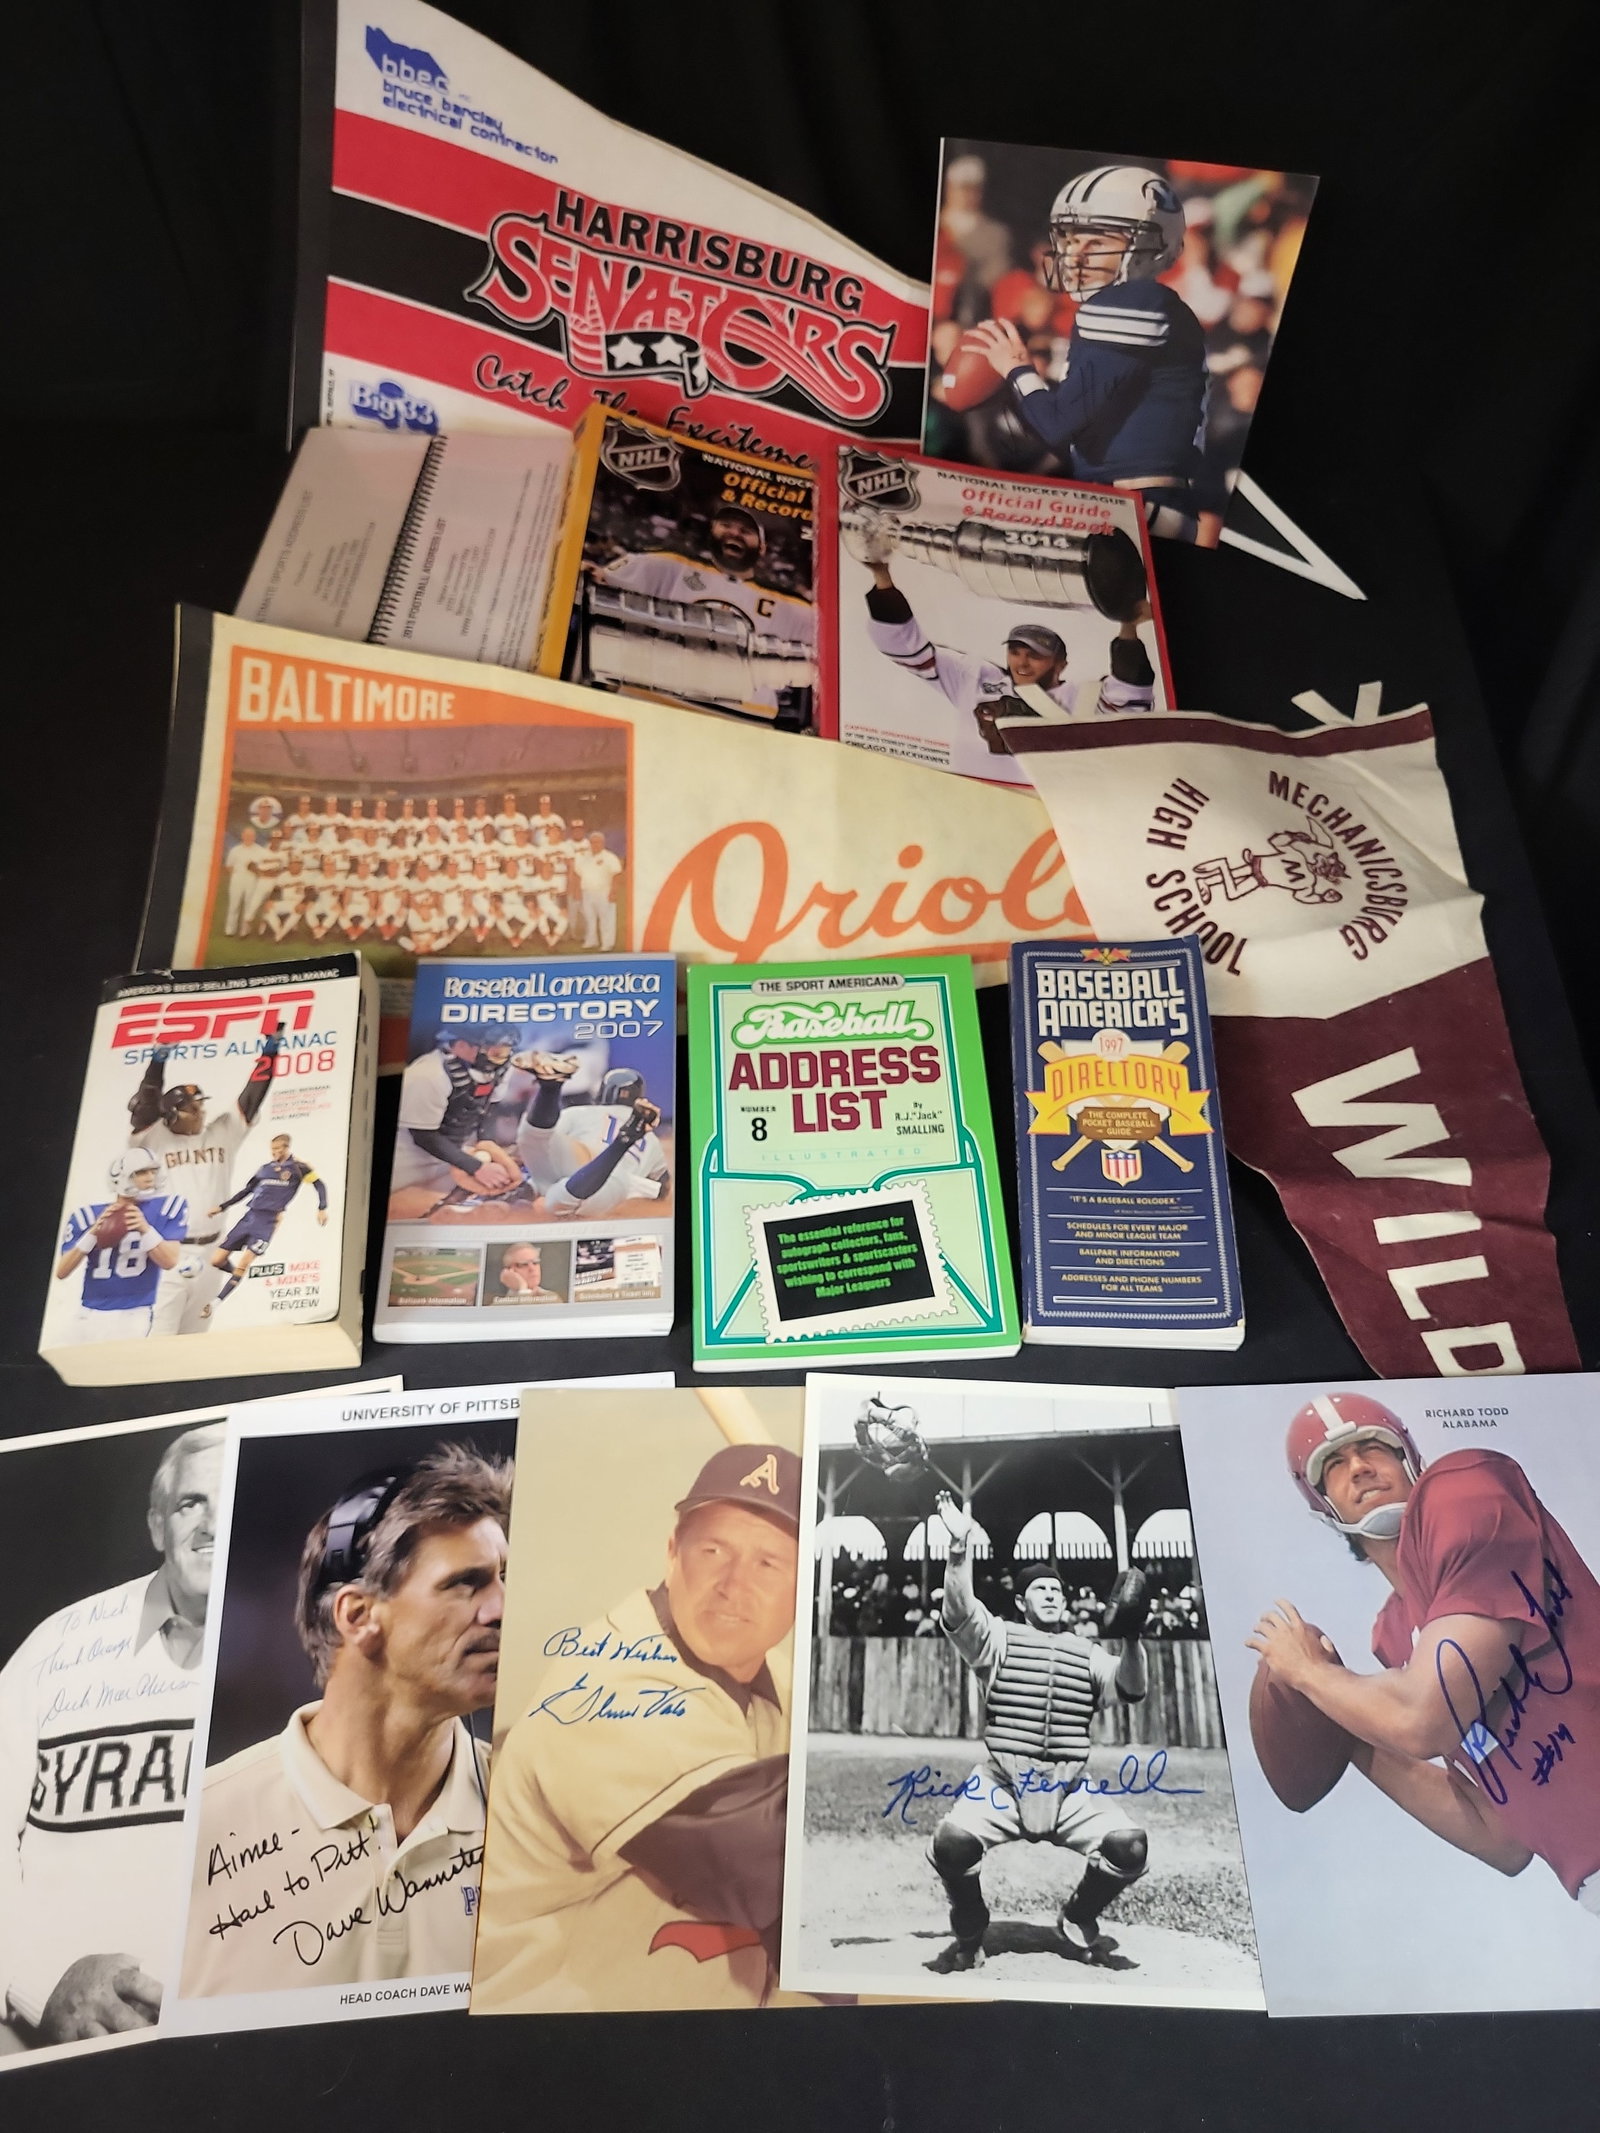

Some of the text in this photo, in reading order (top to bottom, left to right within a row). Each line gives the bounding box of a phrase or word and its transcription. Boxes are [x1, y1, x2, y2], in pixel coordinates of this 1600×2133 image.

[382, 53, 450, 95] bbec
[383, 79, 503, 132] bruce barclay
[383, 95, 559, 165] electrical contractor
[556, 189, 864, 315] HARRISBURG
[466, 215, 896, 424] SENATORS
[476, 355, 568, 411] Catch
[350, 383, 398, 420] Big
[402, 394, 435, 425] 33
[617, 449, 669, 470] NHL
[702, 453, 773, 481] NATIONAL
[721, 488, 736, 502] &
[723, 472, 807, 505] Official
[857, 469, 904, 496] NHL
[936, 470, 1127, 506] NATIONAL HOCKEY LEAGUE
[961, 487, 1112, 519] Official Guide
[962, 505, 1116, 537] & Record Book
[1004, 531, 1072, 550] 2014
[408, 575, 430, 620] FOOTBALL
[757, 599, 776, 619] C
[237, 656, 457, 724] BALTIMORE
[845, 740, 887, 753] CHICAGO
[889, 748, 950, 765] BLACKHAWKS
[1146, 777, 1211, 851] HIGH
[1268, 770, 1409, 961] MECHANICSBURG
[1146, 869, 1248, 977] SCHOOL
[250, 973, 290, 988] SPORTS
[292, 968, 340, 982] ALMANAC
[759, 975, 898, 992] THE SPORT AMERICANA
[1036, 967, 1185, 1001] BASEBALL
[111, 989, 316, 1049] ESPN
[440, 998, 660, 1024] DIRECTORY
[734, 1001, 931, 1045] Baseball
[1037, 997, 1189, 1038] AMERICA'S
[573, 1020, 664, 1040] 2007
[124, 1031, 337, 1066] SPORTS ALMANAC
[1099, 1037, 1124, 1053] 1997
[250, 1049, 336, 1083] 2008
[728, 1045, 942, 1091] ADDRESS
[1052, 1060, 1181, 1102] DIRECTORY
[740, 1105, 777, 1113] NUMBER
[792, 1090, 888, 1134] LIST
[1088, 1111, 1147, 1120] THE COMPLETE
[751, 1117, 768, 1142] 8
[896, 1124, 945, 1136] SMALLING
[1082, 1119, 1156, 1128] POCKET BASEBALL
[1106, 1128, 1131, 1136] GUIDE
[165, 1147, 226, 1171] GIANTS
[761, 1148, 923, 1162] ILLUSTRATED
[1097, 1197, 1135, 1205] BASEBALL
[777, 1216, 904, 1244] The essential reference for
[1066, 1222, 1189, 1232] SCHEDULES FOR EVERY MAJOR
[1074, 1231, 1181, 1240] AND MINOR LEAGUE TEAM
[92, 1231, 148, 1280] 18
[777, 1243, 918, 1275] sportswriters & sportscasters
[781, 1242, 830, 1259] autograph
[831, 1235, 883, 1251] collectors,
[1079, 1248, 1180, 1258] BALLPARK INFORMATION
[251, 1260, 321, 1277] PLUS MIKE
[784, 1258, 916, 1288] wishing to correspond with
[1095, 1257, 1165, 1266] AND DIRECTIONS
[270, 1285, 320, 1299] YEAR IN
[815, 1277, 891, 1299] Major Leaguers
[1061, 1273, 1202, 1284] ADDRESSES AND PHONE NUMBERS
[1101, 1284, 1163, 1293] FOR ALL TEAMS
[271, 1298, 320, 1311] REVIEW
[341, 1398, 520, 1423] UNIVERSITY OF PITTSB
[1425, 1407, 1510, 1418] RICHARD TODD
[1442, 1419, 1498, 1429] ALABAMA
[740, 1454, 780, 1495] A
[543, 1627, 612, 1657] Best
[30, 1734, 193, 1817] SYRA
[881, 1765, 986, 1825] Rick
[284, 1871, 310, 1896] to
[273, 1907, 372, 1966] Dave
[340, 1983, 472, 2005] HEAD COACH DAVE WA
